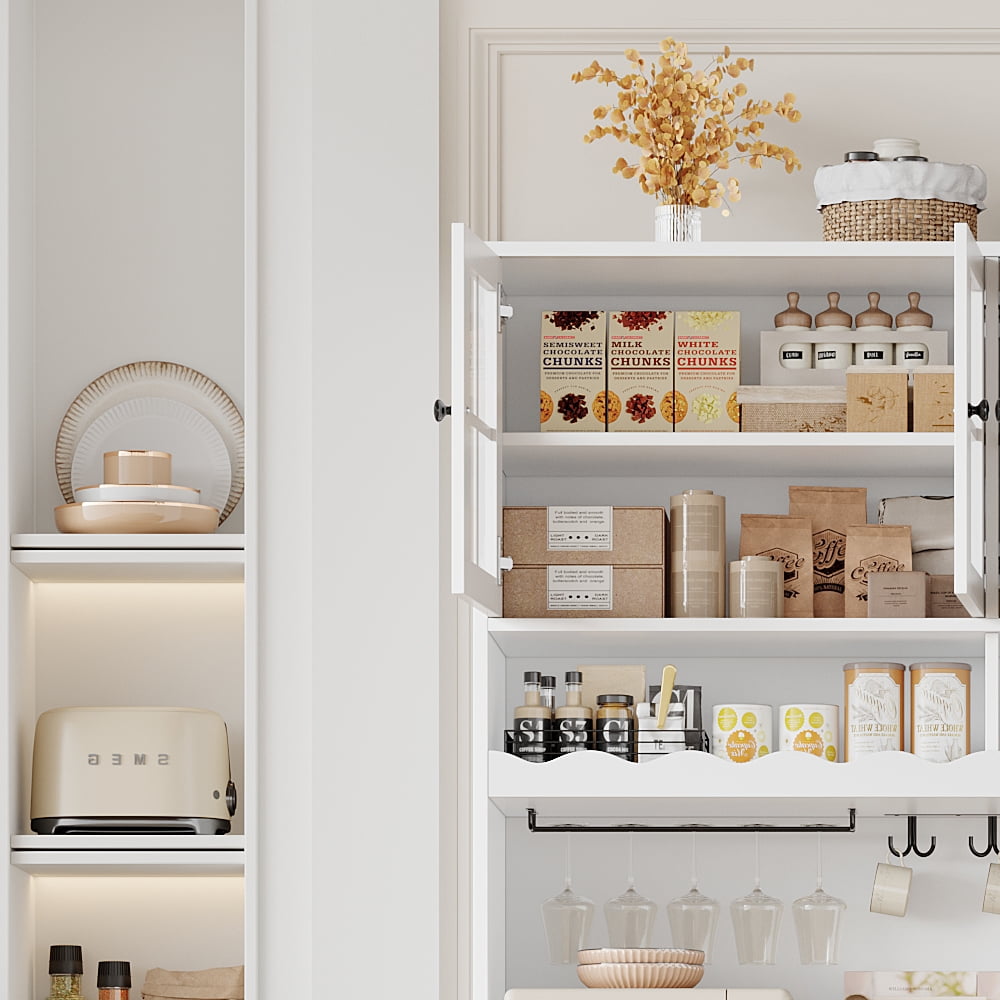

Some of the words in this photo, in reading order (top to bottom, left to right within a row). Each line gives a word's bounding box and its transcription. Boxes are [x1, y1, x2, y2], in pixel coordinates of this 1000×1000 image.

[542, 357, 603, 367] CHUNKS
[610, 357, 671, 367] CHUNKS
[676, 357, 737, 367] CHUNKS
[519, 720, 544, 743] S1
[559, 720, 588, 743] S3
[602, 720, 630, 743] C1
